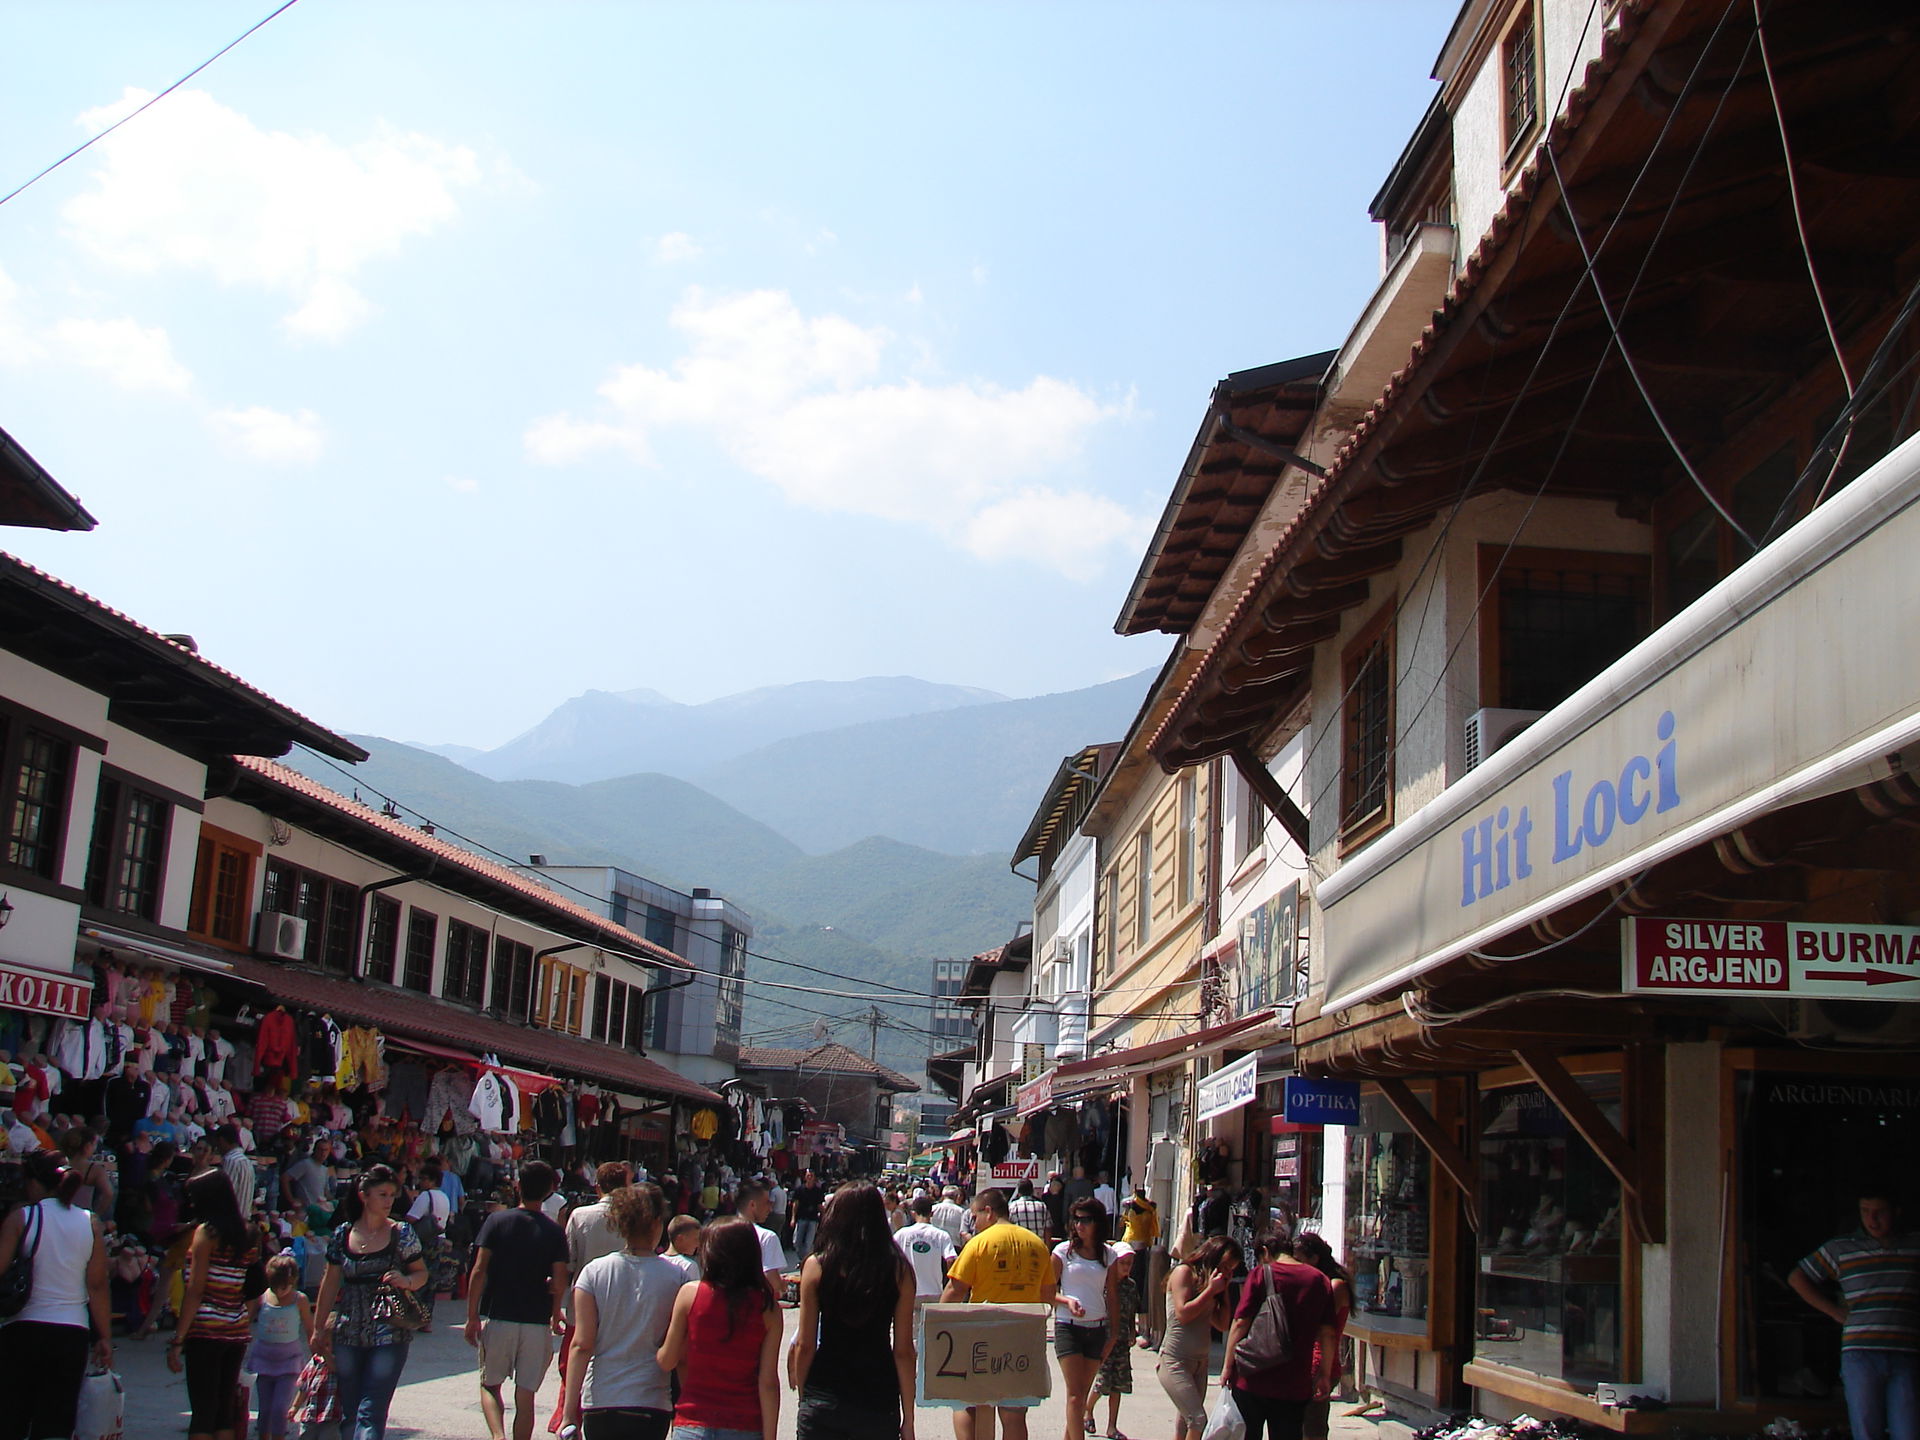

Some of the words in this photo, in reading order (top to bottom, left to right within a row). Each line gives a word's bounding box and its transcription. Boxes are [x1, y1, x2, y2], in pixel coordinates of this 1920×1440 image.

[1461, 805, 1533, 908] Hit
[1552, 710, 1681, 865] Loci
[1665, 923, 1766, 952] SILVER
[1650, 955, 1783, 985] ARGJEND
[0, 972, 81, 1015] KOLLI
[1292, 1092, 1358, 1111] OPTIKA
[936, 1330, 968, 1380] 2
